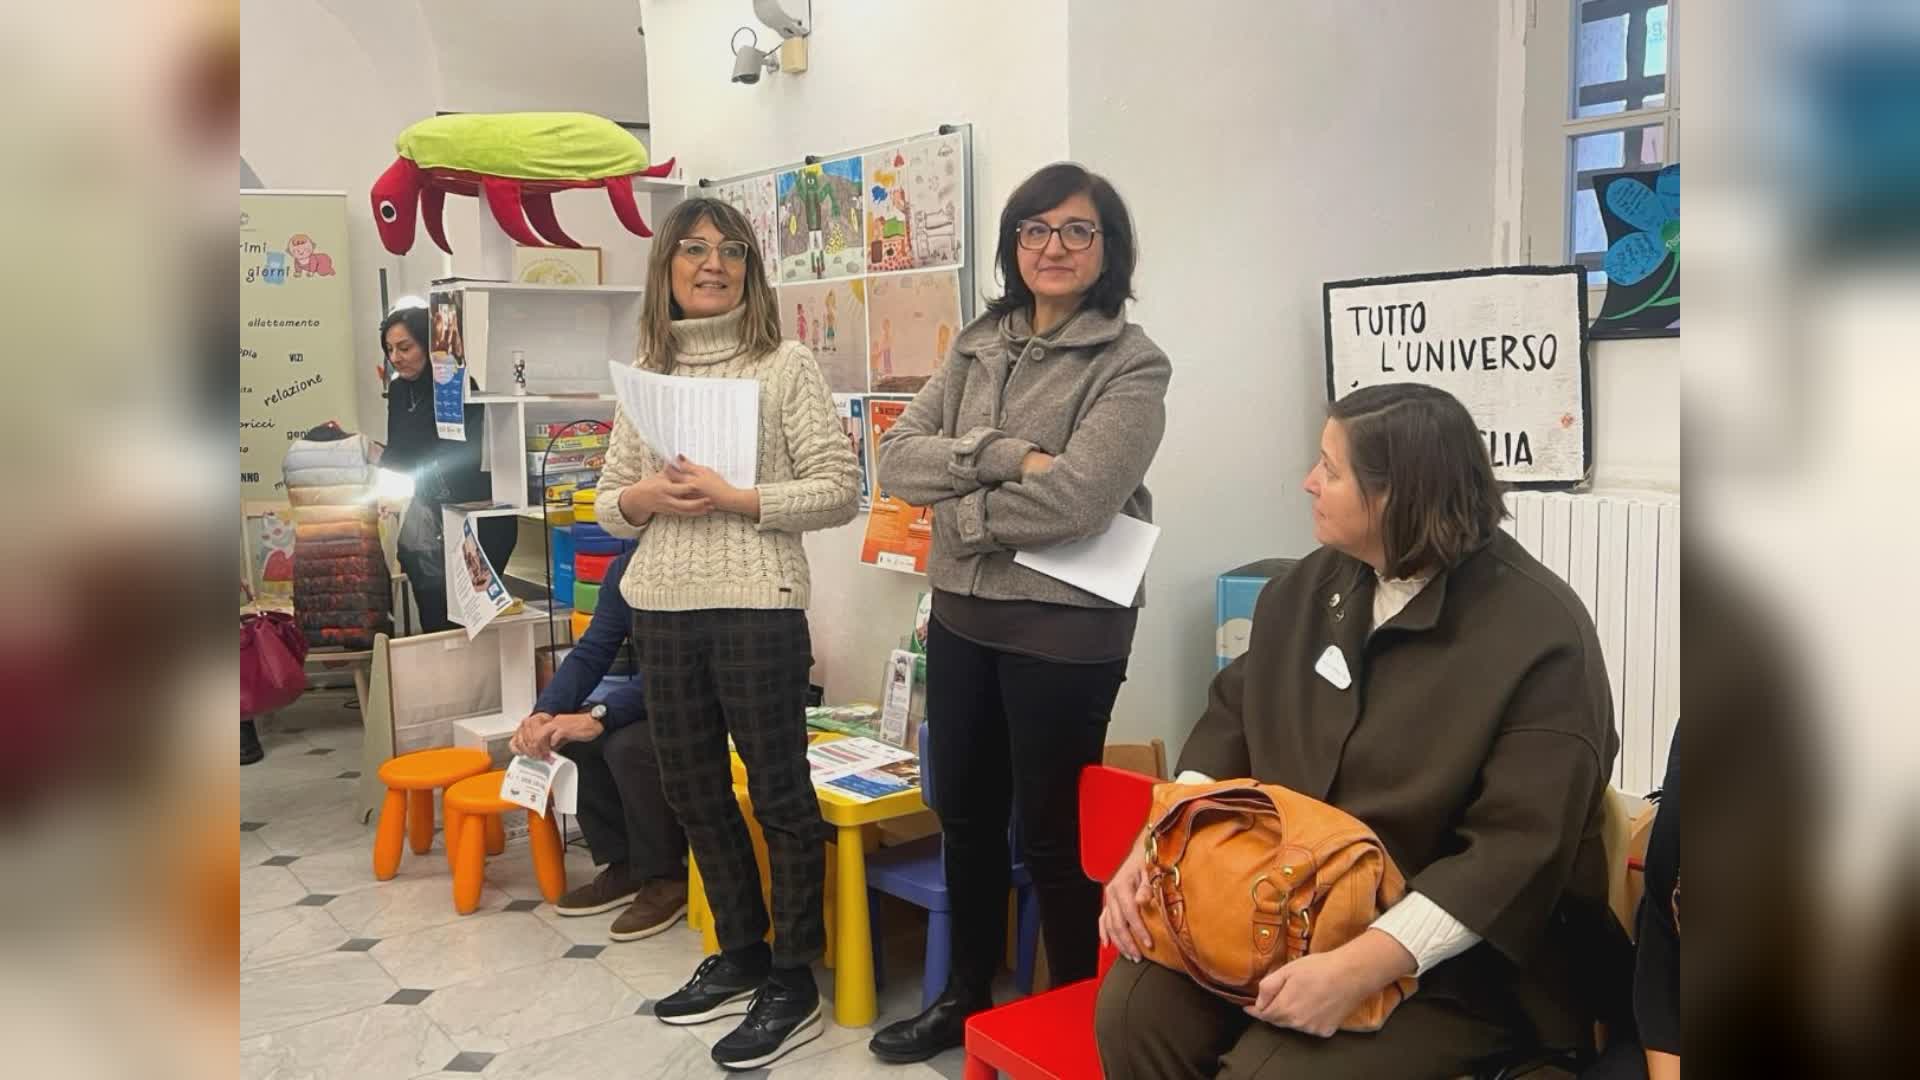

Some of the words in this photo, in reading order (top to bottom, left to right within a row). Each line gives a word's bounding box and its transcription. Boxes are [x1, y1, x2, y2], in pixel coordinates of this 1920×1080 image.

[245, 264, 290, 283] giorni
[247, 317, 320, 328] allattamento
[1346, 301, 1427, 336] TUTTO
[1381, 333, 1558, 373] L'UNIVERSO
[264, 373, 323, 407] relazione
[1480, 430, 1533, 466] LIA
